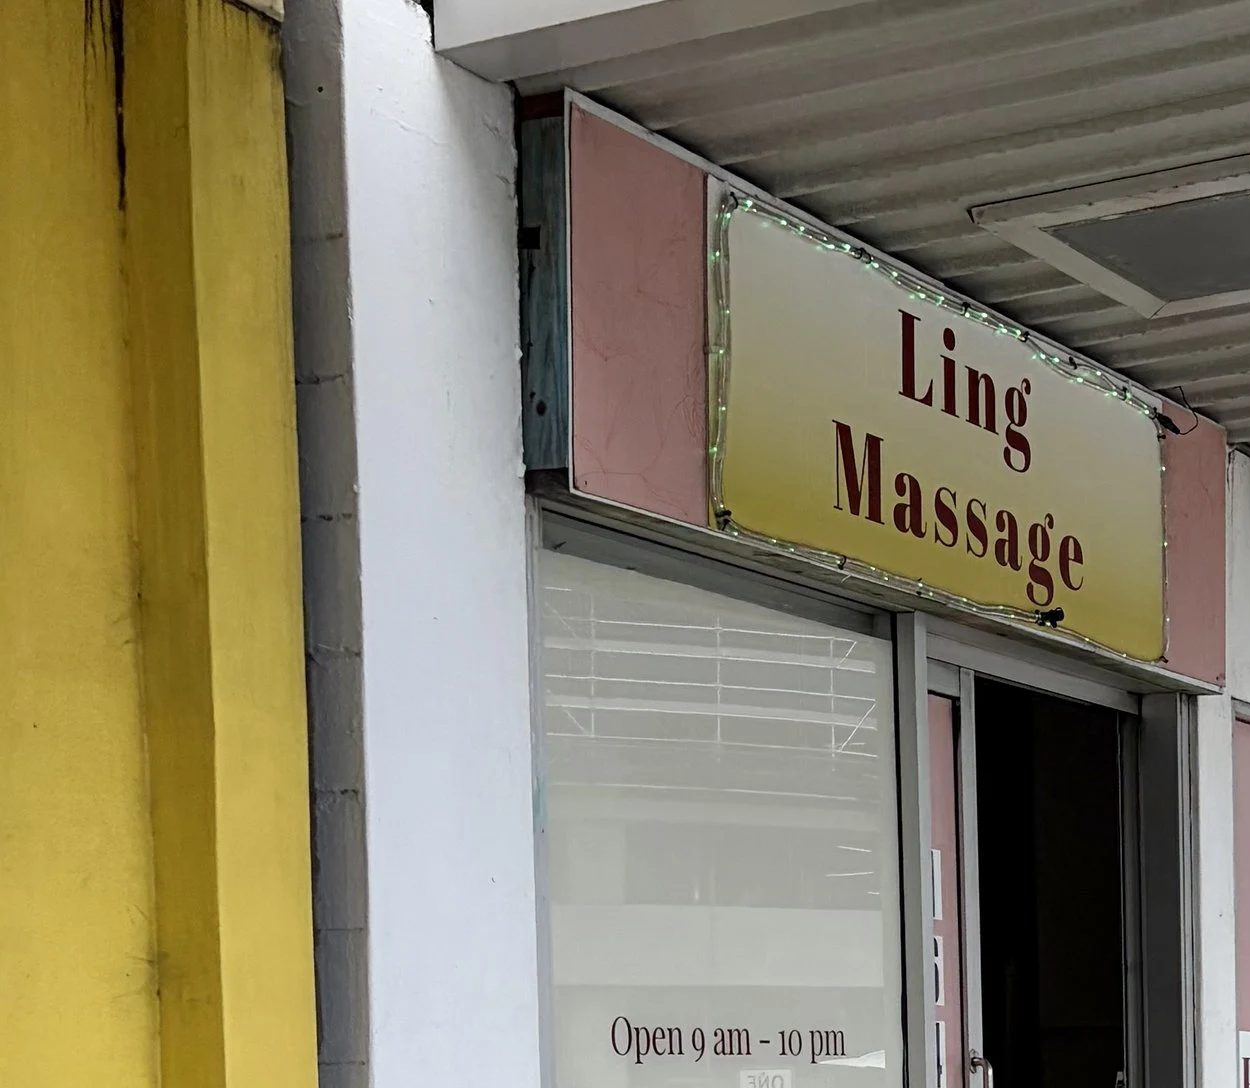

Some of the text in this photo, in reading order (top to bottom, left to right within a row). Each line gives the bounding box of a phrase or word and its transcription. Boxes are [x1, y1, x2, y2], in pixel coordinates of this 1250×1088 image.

[898, 309, 1032, 473] Ling
[832, 420, 1084, 606] Massage
[611, 1015, 685, 1064] Open
[691, 1027, 705, 1063] 9
[713, 1027, 752, 1056] am
[778, 1028, 802, 1057] 10
[809, 1027, 846, 1064] pm
